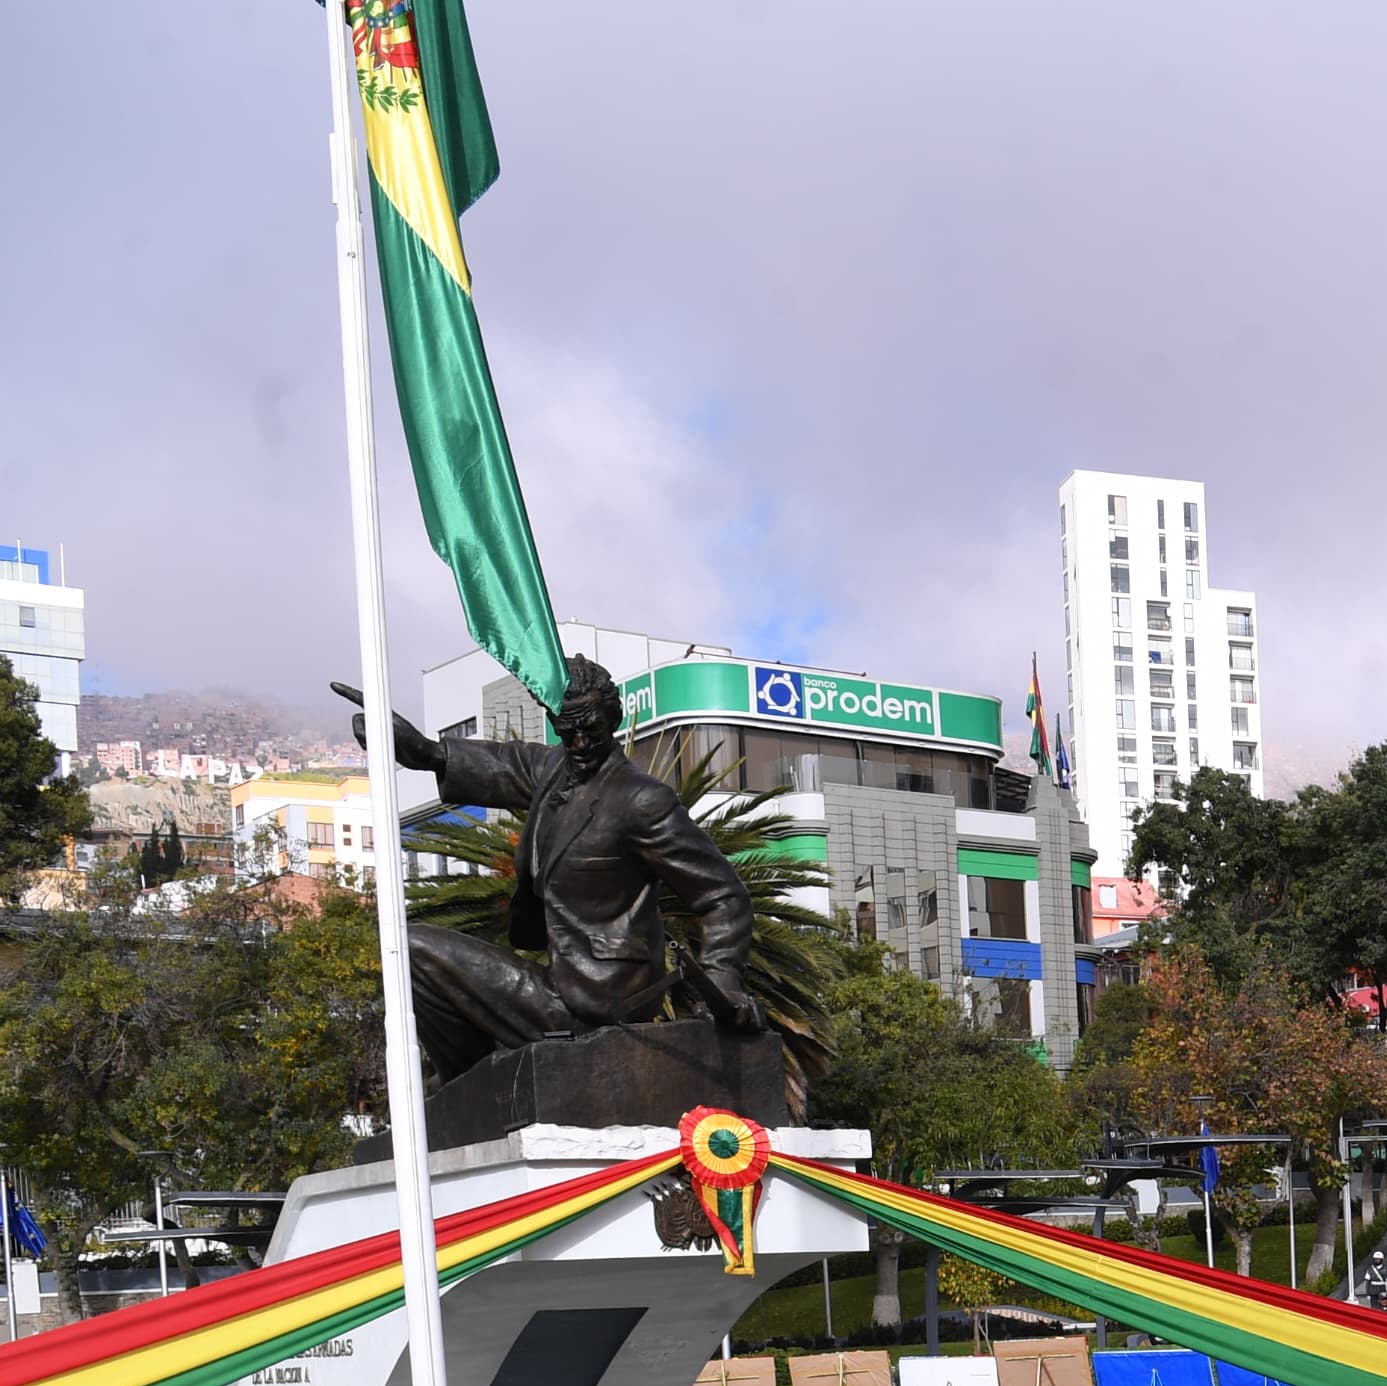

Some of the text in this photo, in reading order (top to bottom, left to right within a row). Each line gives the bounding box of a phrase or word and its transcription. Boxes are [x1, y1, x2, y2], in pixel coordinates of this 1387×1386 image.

[803, 676, 837, 689] banco
[804, 684, 932, 724] prodem
[158, 750, 198, 780] LA
